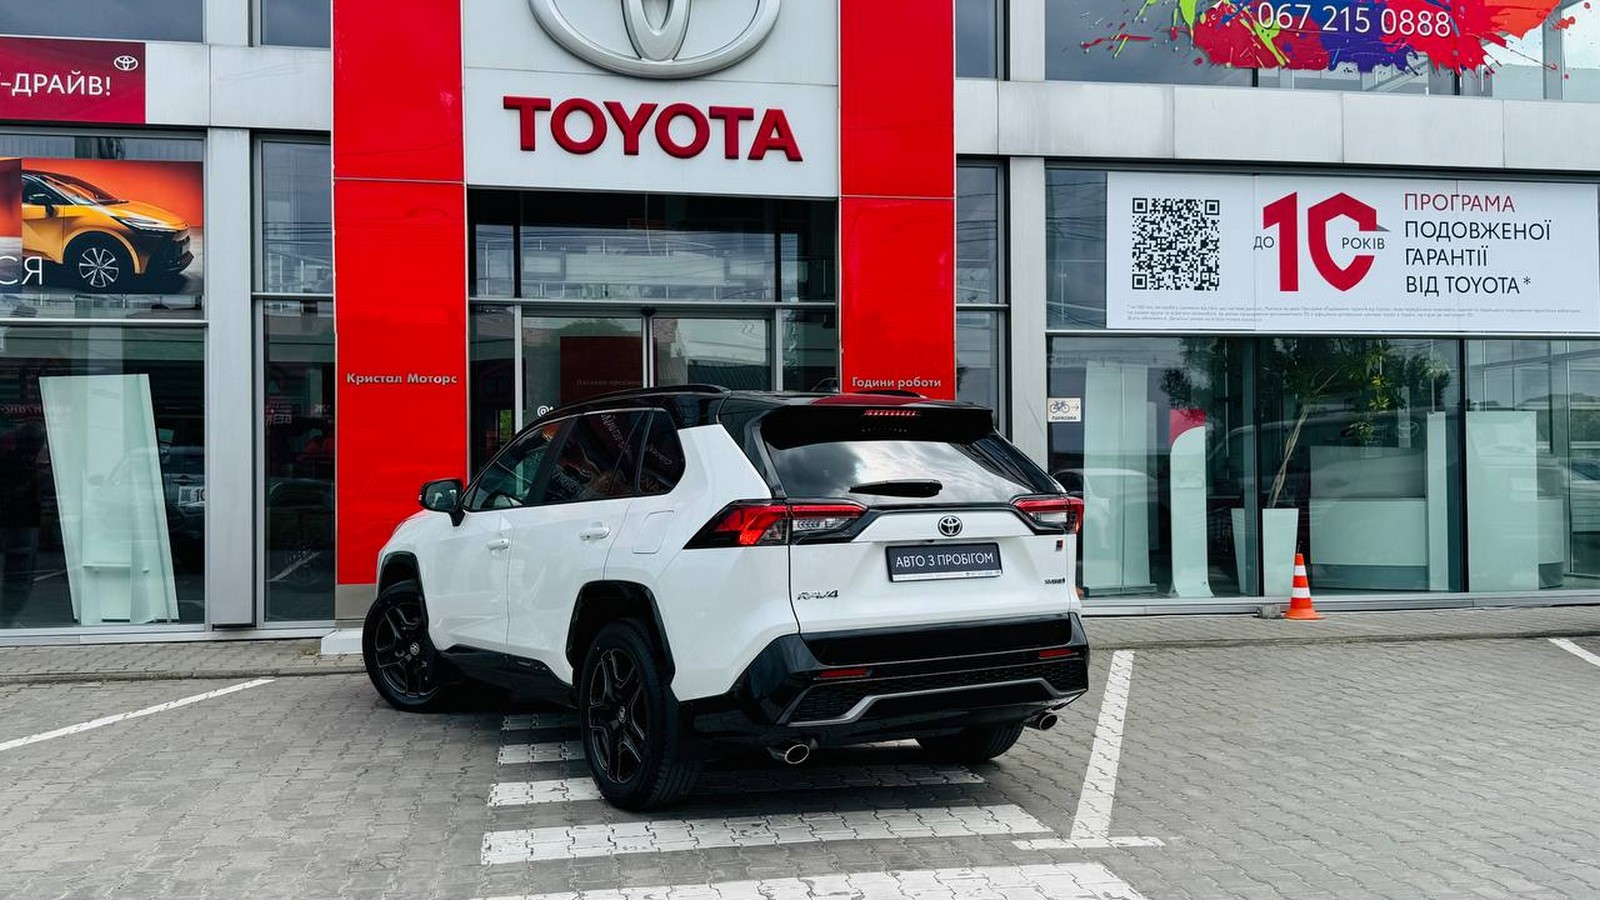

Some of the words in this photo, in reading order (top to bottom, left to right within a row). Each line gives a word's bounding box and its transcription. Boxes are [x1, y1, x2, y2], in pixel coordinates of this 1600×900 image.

[1258, 2, 1311, 29] 067
[1322, 5, 1371, 33] 215
[1380, 8, 1452, 37] 0888
[0, 70, 111, 97] -ДРАЙВ!
[502, 95, 804, 162] TOYOTA
[1404, 193, 1515, 213] ПРОГРАМА
[1404, 219, 1551, 243] ПОДОВЖЕНОЇ
[1253, 235, 1275, 252] ДО
[1263, 191, 1377, 293] 10
[1341, 236, 1386, 250] РОКІВ
[1404, 245, 1488, 267] ГАРАНТІЇ
[1406, 275, 1439, 297] ВІД
[346, 373, 403, 386] Кристал
[406, 373, 458, 387] Моторс
[851, 376, 896, 388] Години
[898, 376, 943, 390] роботи
[895, 554, 926, 568] АВТО
[937, 552, 994, 566] ПРОБІГОМ
[797, 589, 839, 601] RAV4
